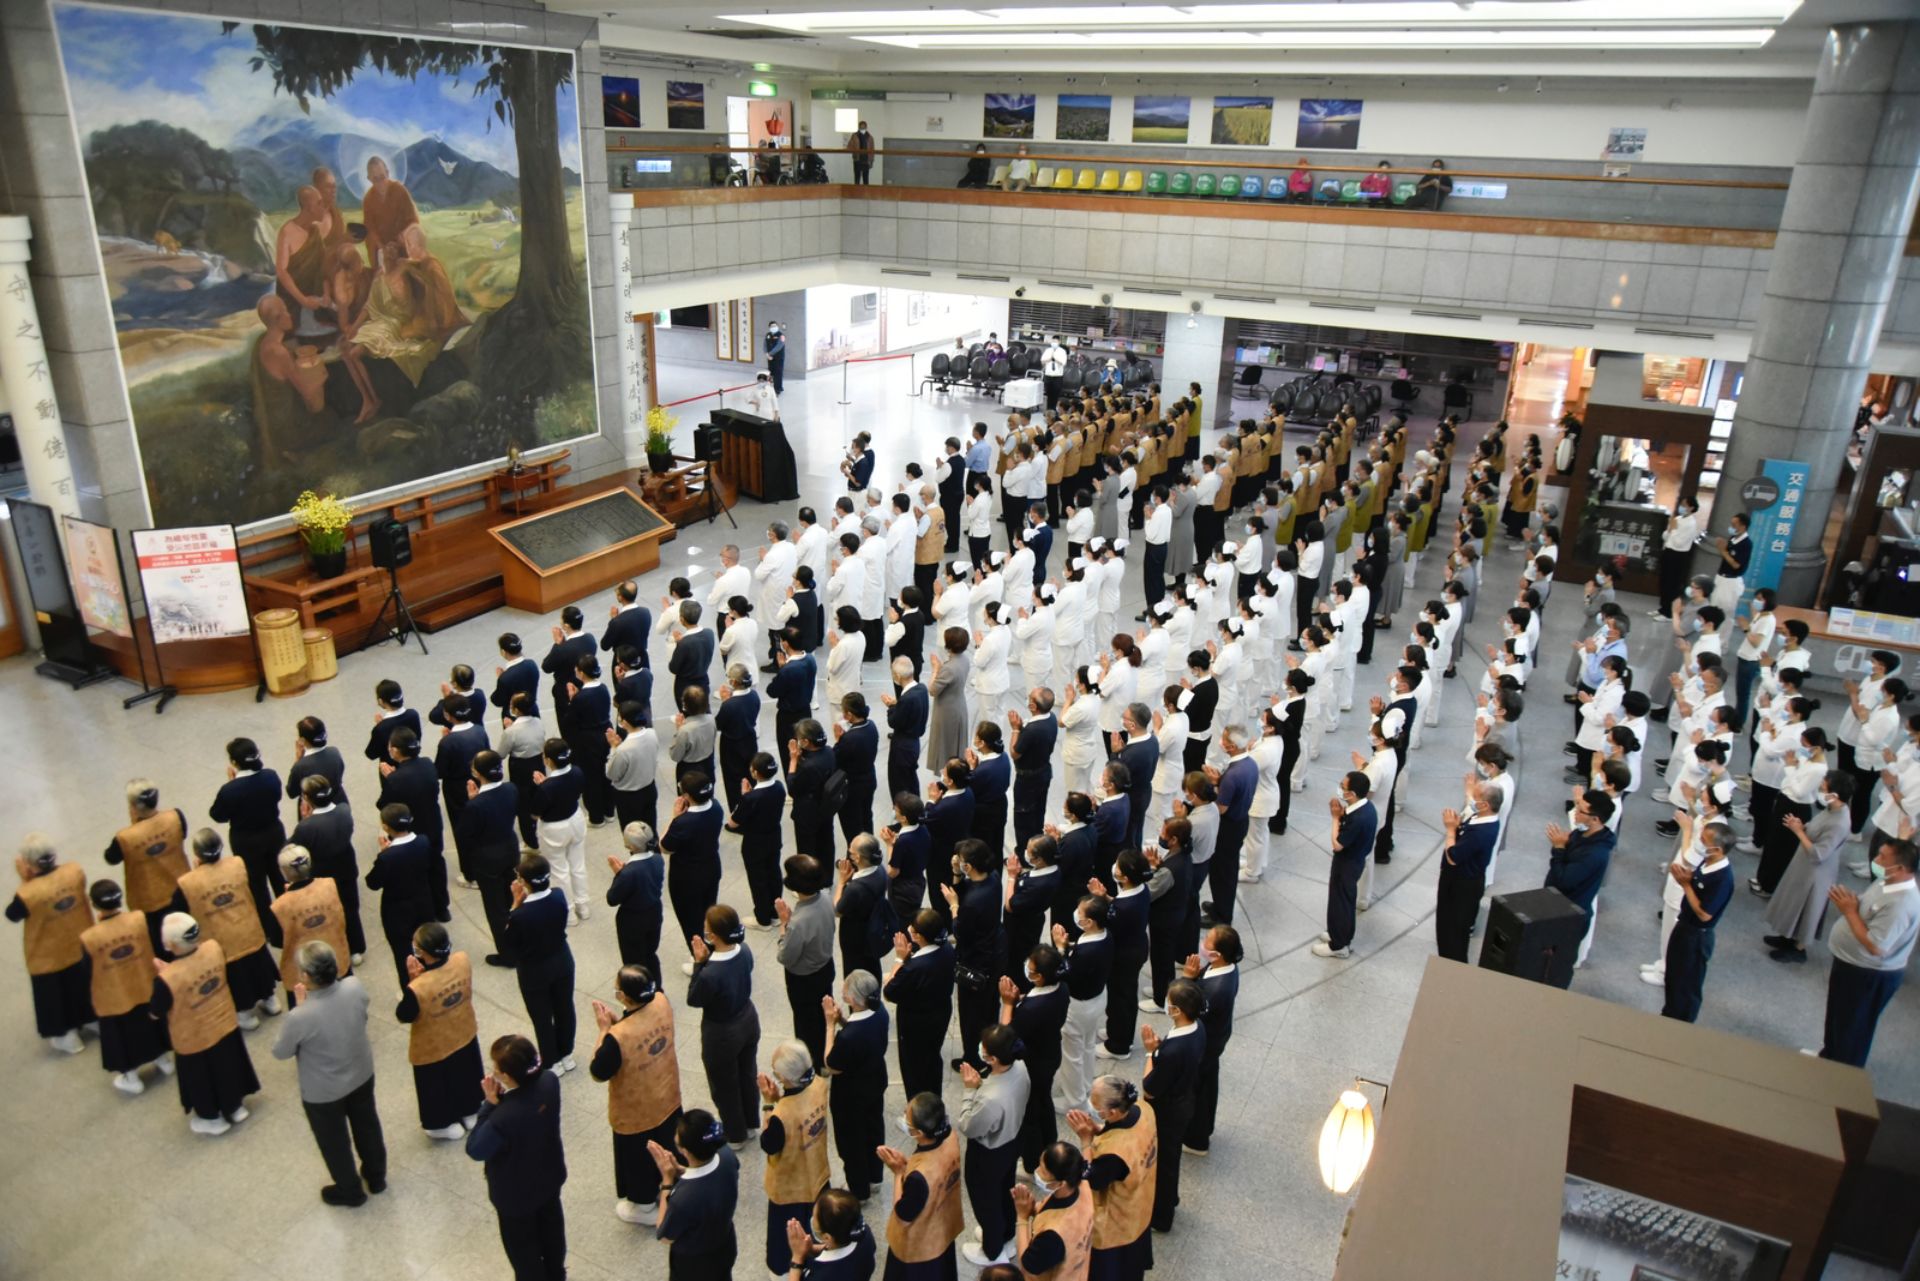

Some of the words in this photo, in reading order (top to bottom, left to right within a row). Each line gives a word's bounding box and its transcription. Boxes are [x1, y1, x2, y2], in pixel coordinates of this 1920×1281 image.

[1770, 472, 1805, 553] 交通服務台
